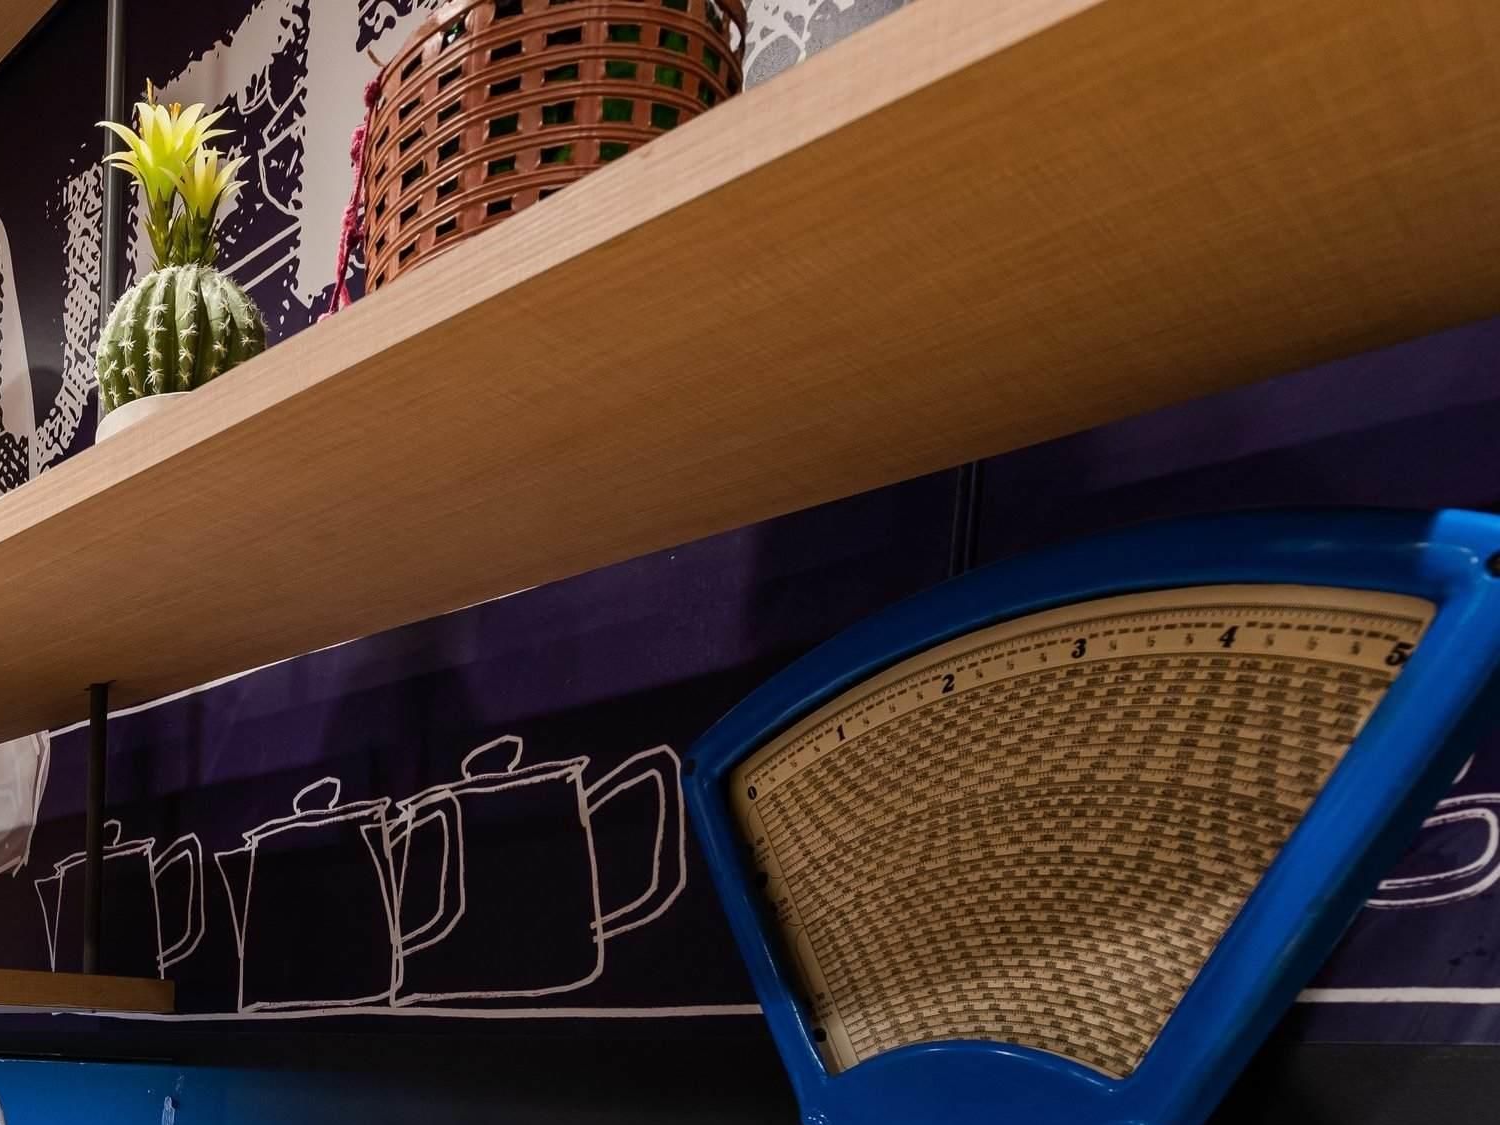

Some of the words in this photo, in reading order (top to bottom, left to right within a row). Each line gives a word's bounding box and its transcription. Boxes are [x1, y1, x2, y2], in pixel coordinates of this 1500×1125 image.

[942, 673, 955, 694] 2
[1071, 638, 1087, 659] 3
[1219, 625, 1239, 648] 4
[1385, 642, 1414, 667] 5
